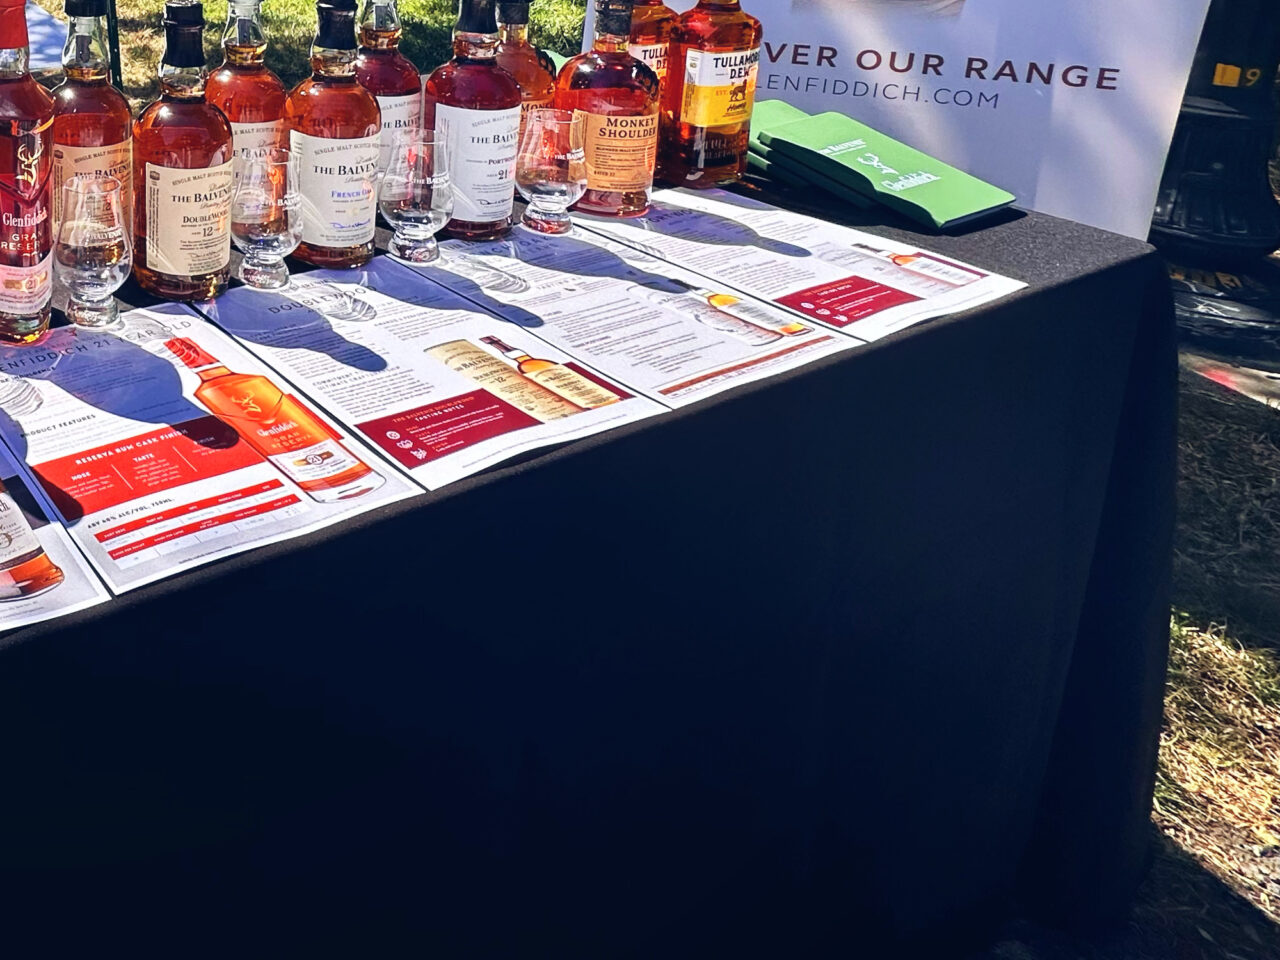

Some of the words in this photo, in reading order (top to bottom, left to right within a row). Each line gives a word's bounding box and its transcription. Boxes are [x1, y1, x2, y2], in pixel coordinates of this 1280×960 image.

[642, 49, 668, 60] TULLA
[763, 41, 837, 68] VER
[856, 48, 945, 77] OUR
[965, 60, 1120, 91] RANGE
[1246, 68, 1261, 87] 9
[757, 74, 999, 110] LENFIDDICH.COM
[606, 118, 655, 128] MONKEY
[472, 136, 490, 144] THE
[313, 166, 335, 175] THE
[338, 162, 378, 176] BALVEN
[498, 169, 508, 180] 21
[192, 173, 207, 181] MALT
[194, 188, 230, 203] BALVEN
[331, 190, 361, 198] FRENCH
[202, 226, 214, 238] 12
[95, 338, 112, 350] 21
[494, 376, 507, 384] 12
[414, 411, 443, 422] TASTING
[444, 404, 465, 413] NOTES
[58, 414, 97, 429] FEATURES
[257, 420, 300, 439] Glenfiddich
[76, 450, 114, 466] RESERVA
[114, 444, 136, 455] RUM
[136, 436, 159, 449] CASK
[160, 429, 189, 443] FINISH
[133, 453, 155, 464] TASTE
[307, 454, 321, 465] 21
[71, 472, 91, 482] NOSE
